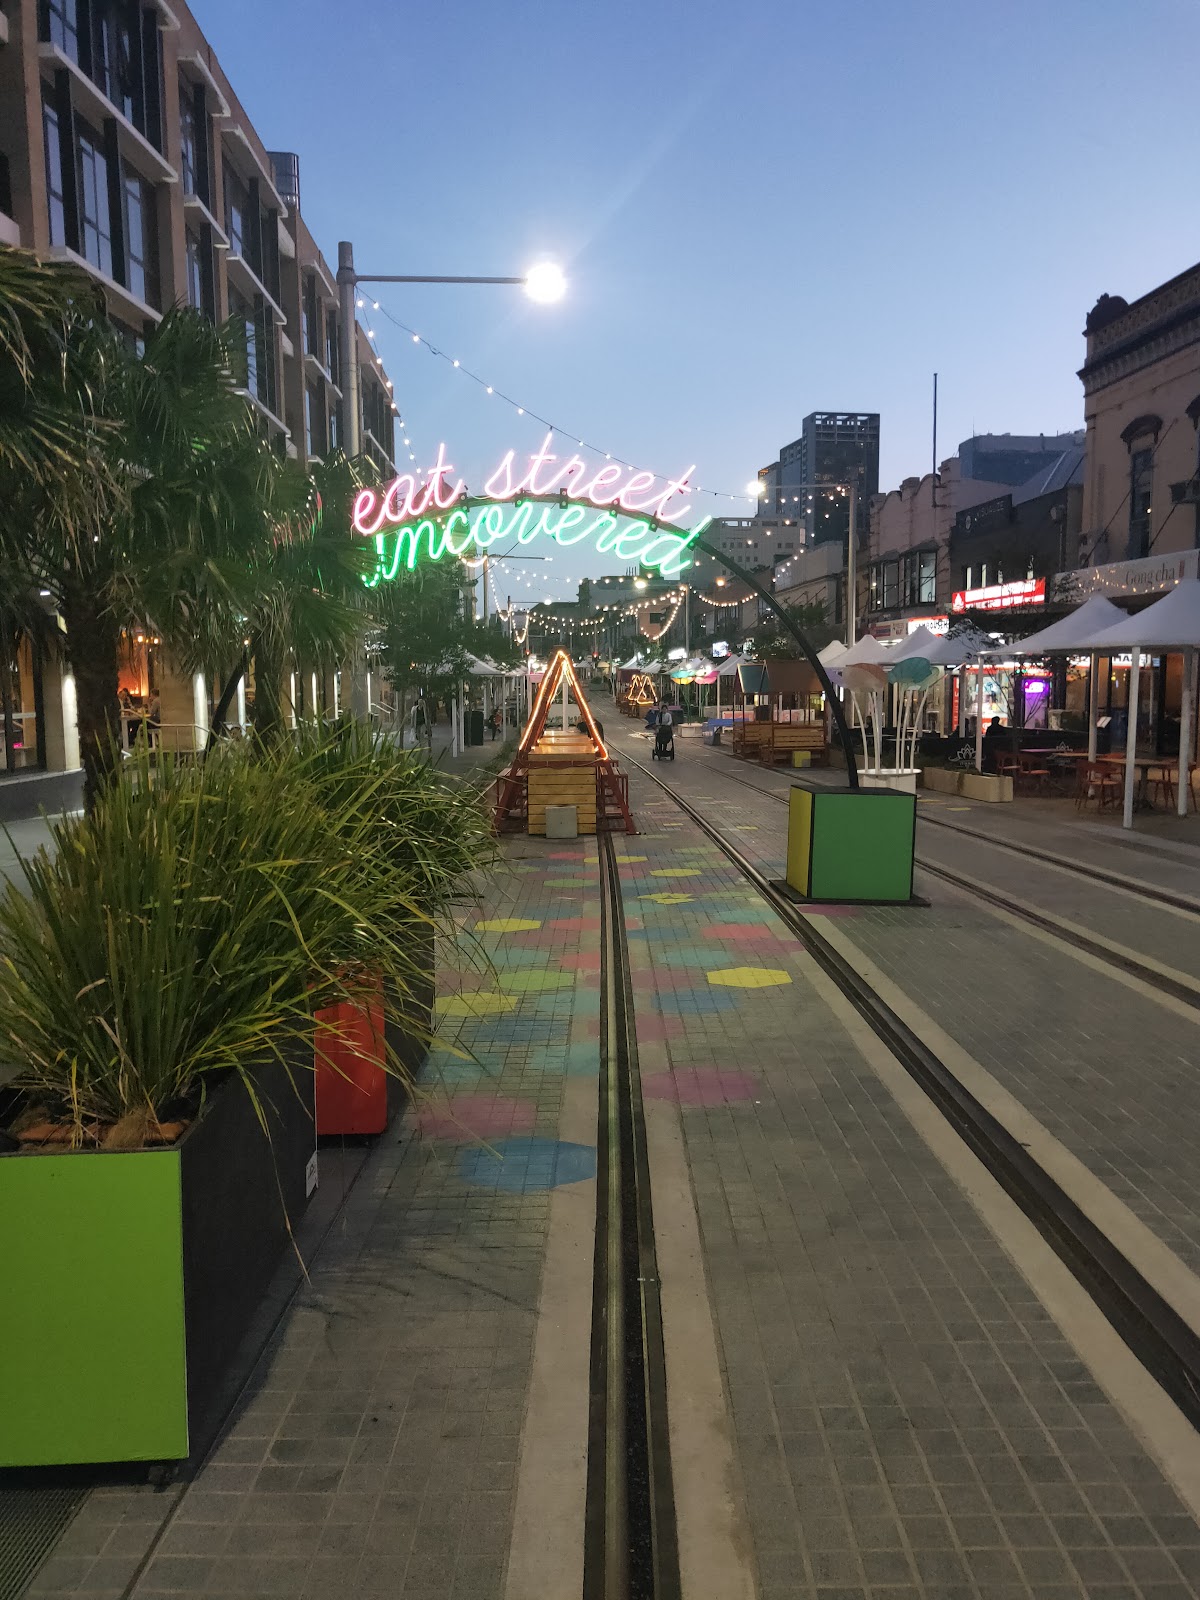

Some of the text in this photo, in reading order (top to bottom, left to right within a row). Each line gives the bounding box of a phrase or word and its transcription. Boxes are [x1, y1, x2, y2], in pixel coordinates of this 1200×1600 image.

[352, 432, 697, 534] eat street
[1125, 569, 1154, 586] Gong
[1155, 562, 1175, 582] cha
